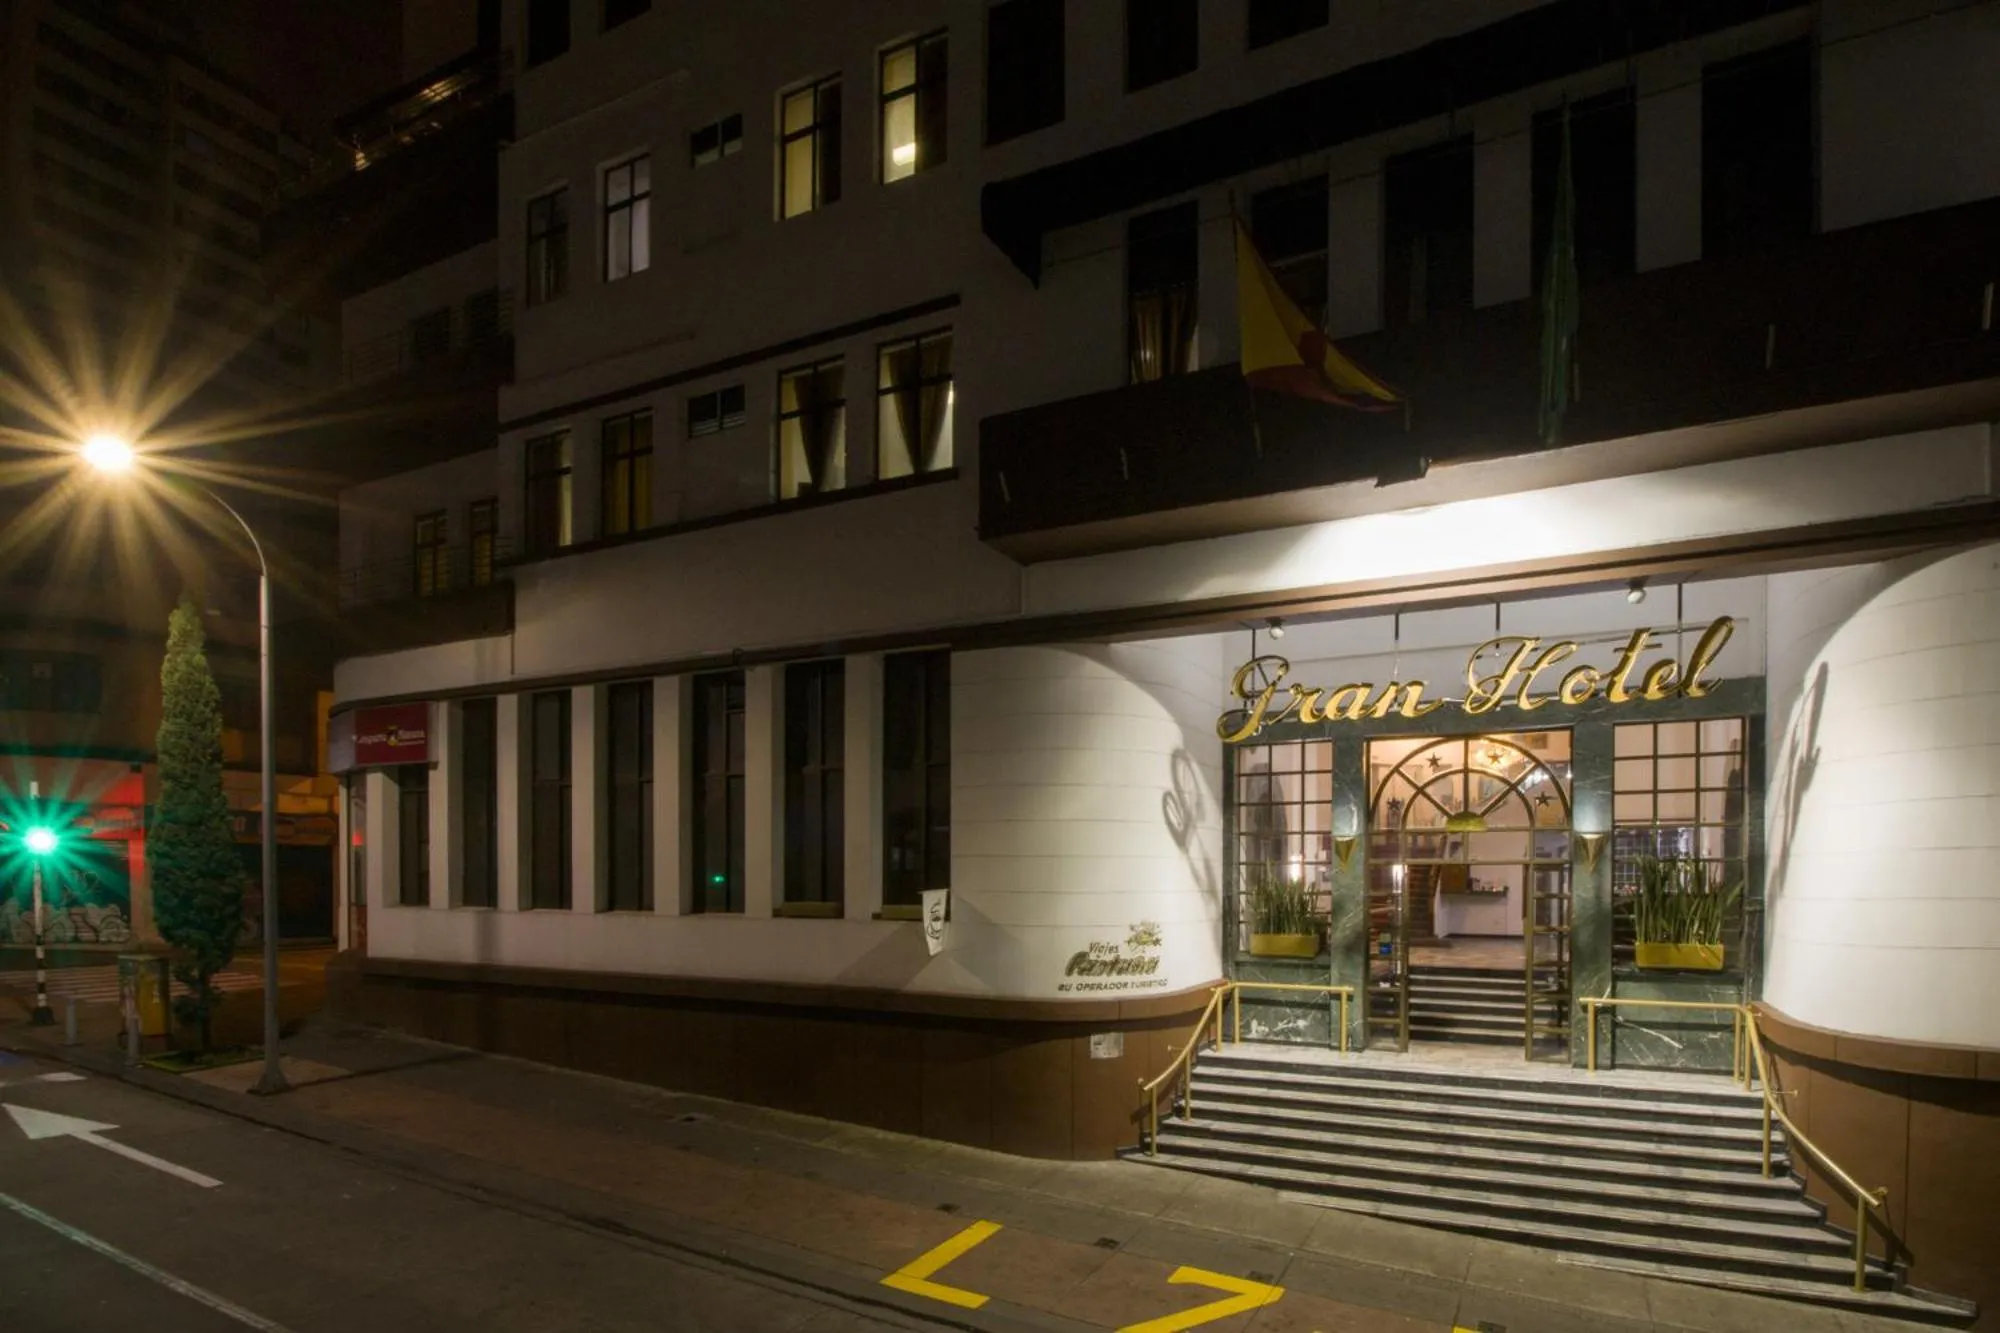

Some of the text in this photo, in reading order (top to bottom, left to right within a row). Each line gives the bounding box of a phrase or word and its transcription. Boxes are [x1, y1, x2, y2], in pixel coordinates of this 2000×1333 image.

[1216, 615, 1735, 743] Gran Hotel
[1089, 941, 1120, 956] Viajes
[1076, 981, 1129, 991] OPERADOR
